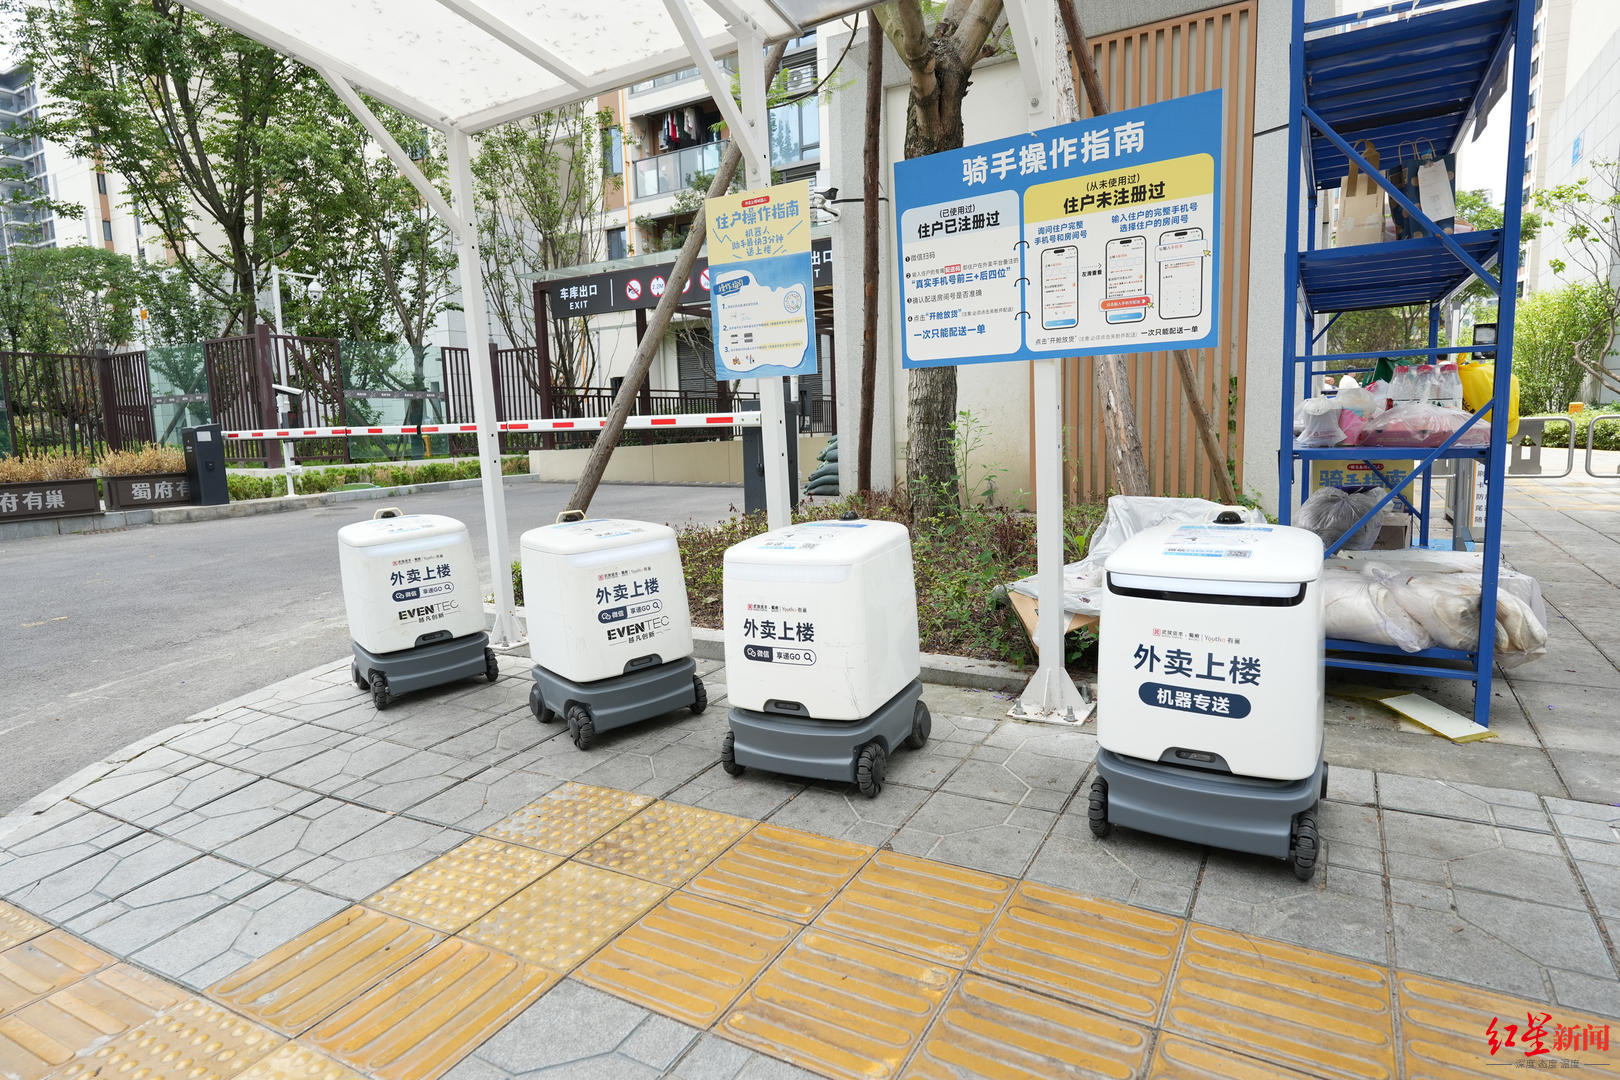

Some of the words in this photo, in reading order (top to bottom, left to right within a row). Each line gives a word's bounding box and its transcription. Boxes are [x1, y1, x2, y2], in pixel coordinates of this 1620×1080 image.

[962, 120, 1145, 186] 骑手操作指南
[1085, 173, 1140, 192] (从未使用过)
[1063, 181, 1165, 214] 住户未注册过
[716, 200, 799, 229] 住户操作指南
[939, 204, 976, 218] (已使用过)
[1111, 202, 1198, 224] 输入住户的完整手机号
[745, 226, 770, 237] 机器人
[917, 210, 1000, 239] 住户已注册过
[1037, 220, 1084, 235] 询问住户完整
[1119, 213, 1189, 232] 选择住户的房间号
[1034, 230, 1087, 245] 手机号和房间号
[746, 246, 772, 256] 送上楼
[559, 284, 597, 300] 车库出口
[569, 301, 588, 310] EXIT
[914, 324, 986, 340] 一次只能配送一单
[1141, 325, 1199, 337] 一次只能配送一单
[0, 489, 65, 513] 府有巢
[390, 563, 451, 586] 外卖上楼
[596, 577, 659, 605] 外卖上楼
[398, 600, 459, 620] EVENTEC
[606, 615, 670, 641] EVENTEC
[744, 618, 814, 642] 外卖上楼
[1133, 643, 1261, 686] 外卖上楼
[1156, 688, 1230, 714] 机器专送
